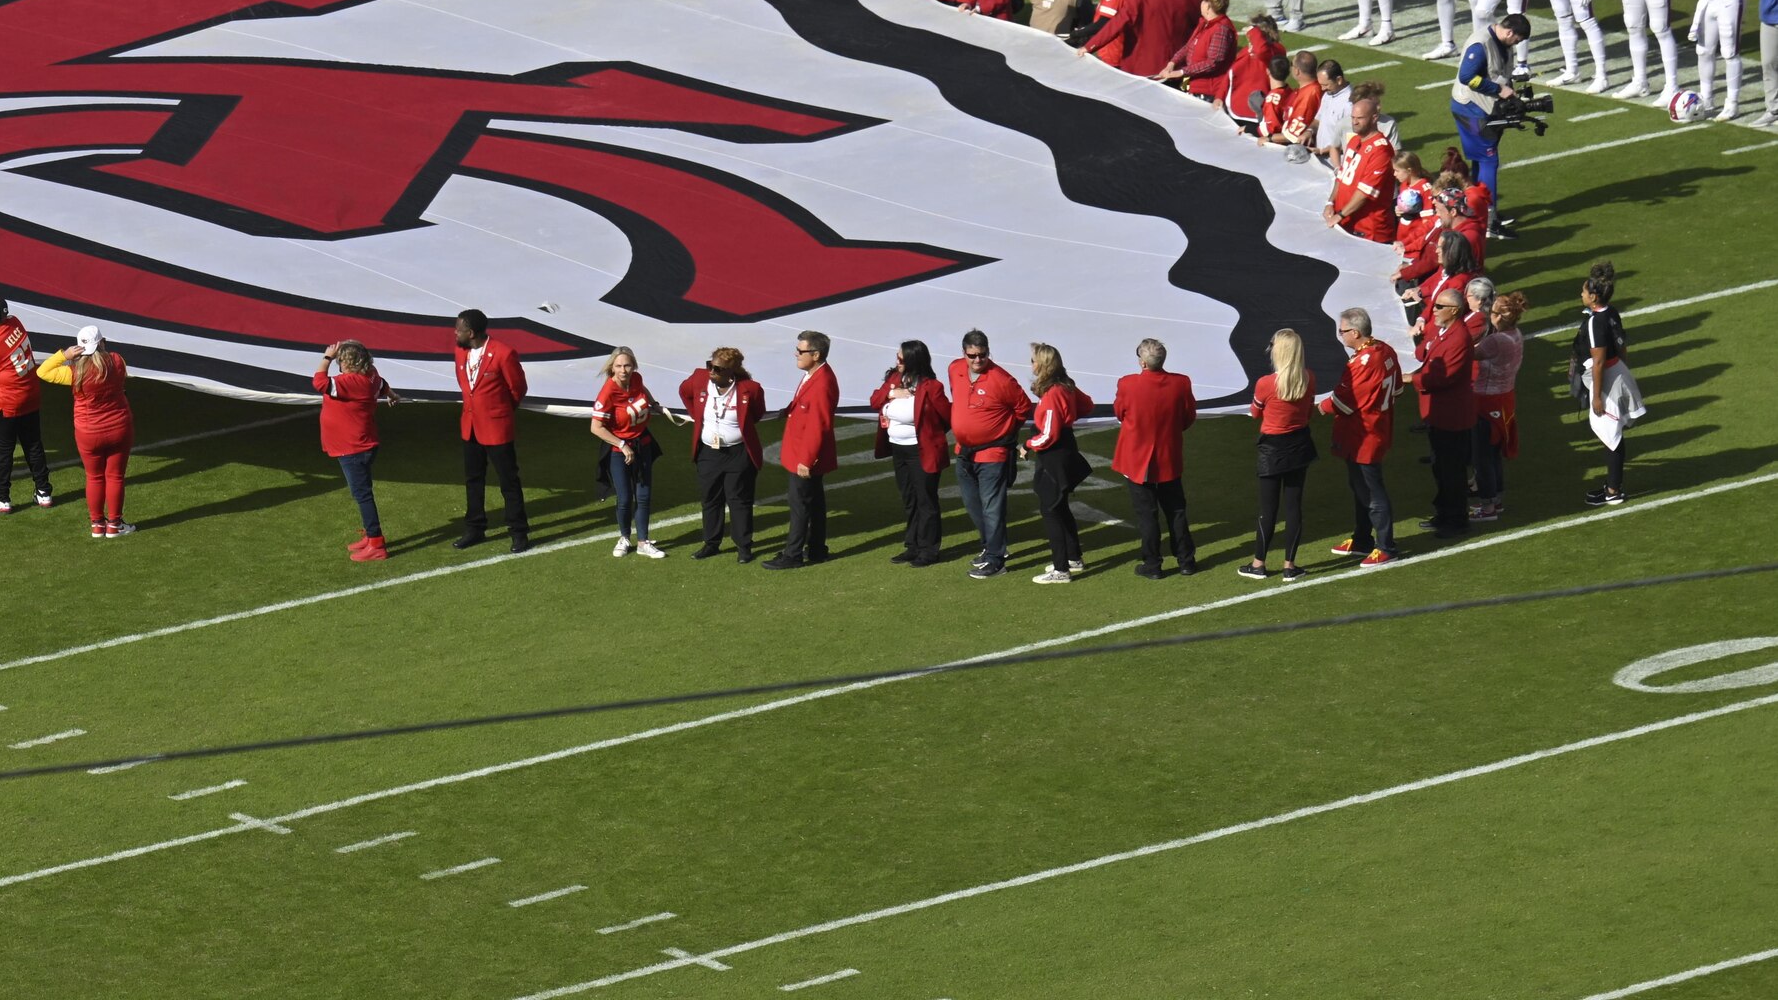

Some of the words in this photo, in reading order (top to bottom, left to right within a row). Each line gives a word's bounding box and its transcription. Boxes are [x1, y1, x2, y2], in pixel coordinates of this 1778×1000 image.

[1288, 118, 1306, 135] 37
[1338, 148, 1362, 185] 58
[4, 326, 24, 349] KELCE
[9, 340, 36, 377] 87
